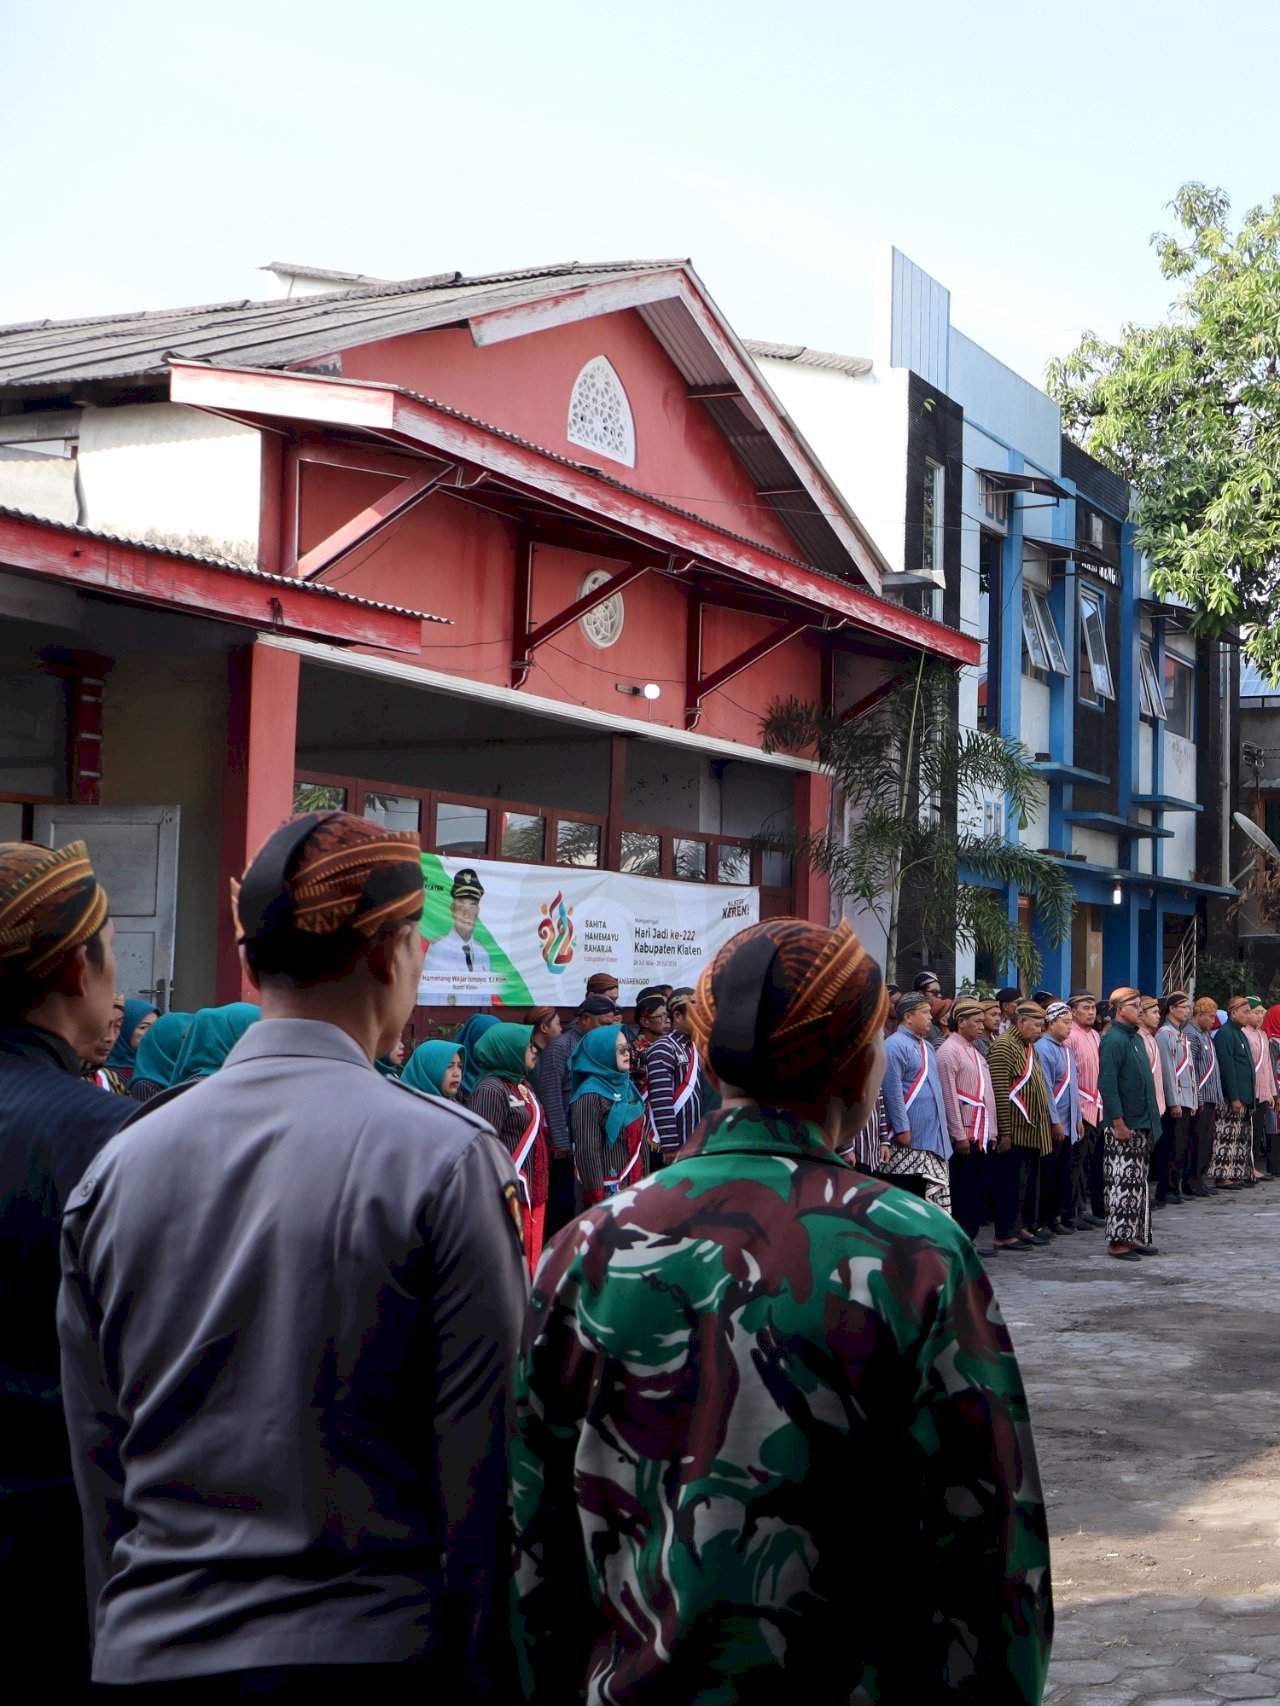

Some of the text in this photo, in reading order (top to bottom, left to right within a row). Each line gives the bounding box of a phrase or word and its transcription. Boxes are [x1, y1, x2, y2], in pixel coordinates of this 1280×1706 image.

[722, 905, 749, 919] KEREN!
[585, 920, 606, 928] SAHITA
[585, 932, 619, 941] HAMEMAYU
[634, 927, 696, 941] Hari Jadi ke-222
[584, 944, 612, 953] RAHARJA
[634, 942, 702, 956] Kabupaten Klaten
